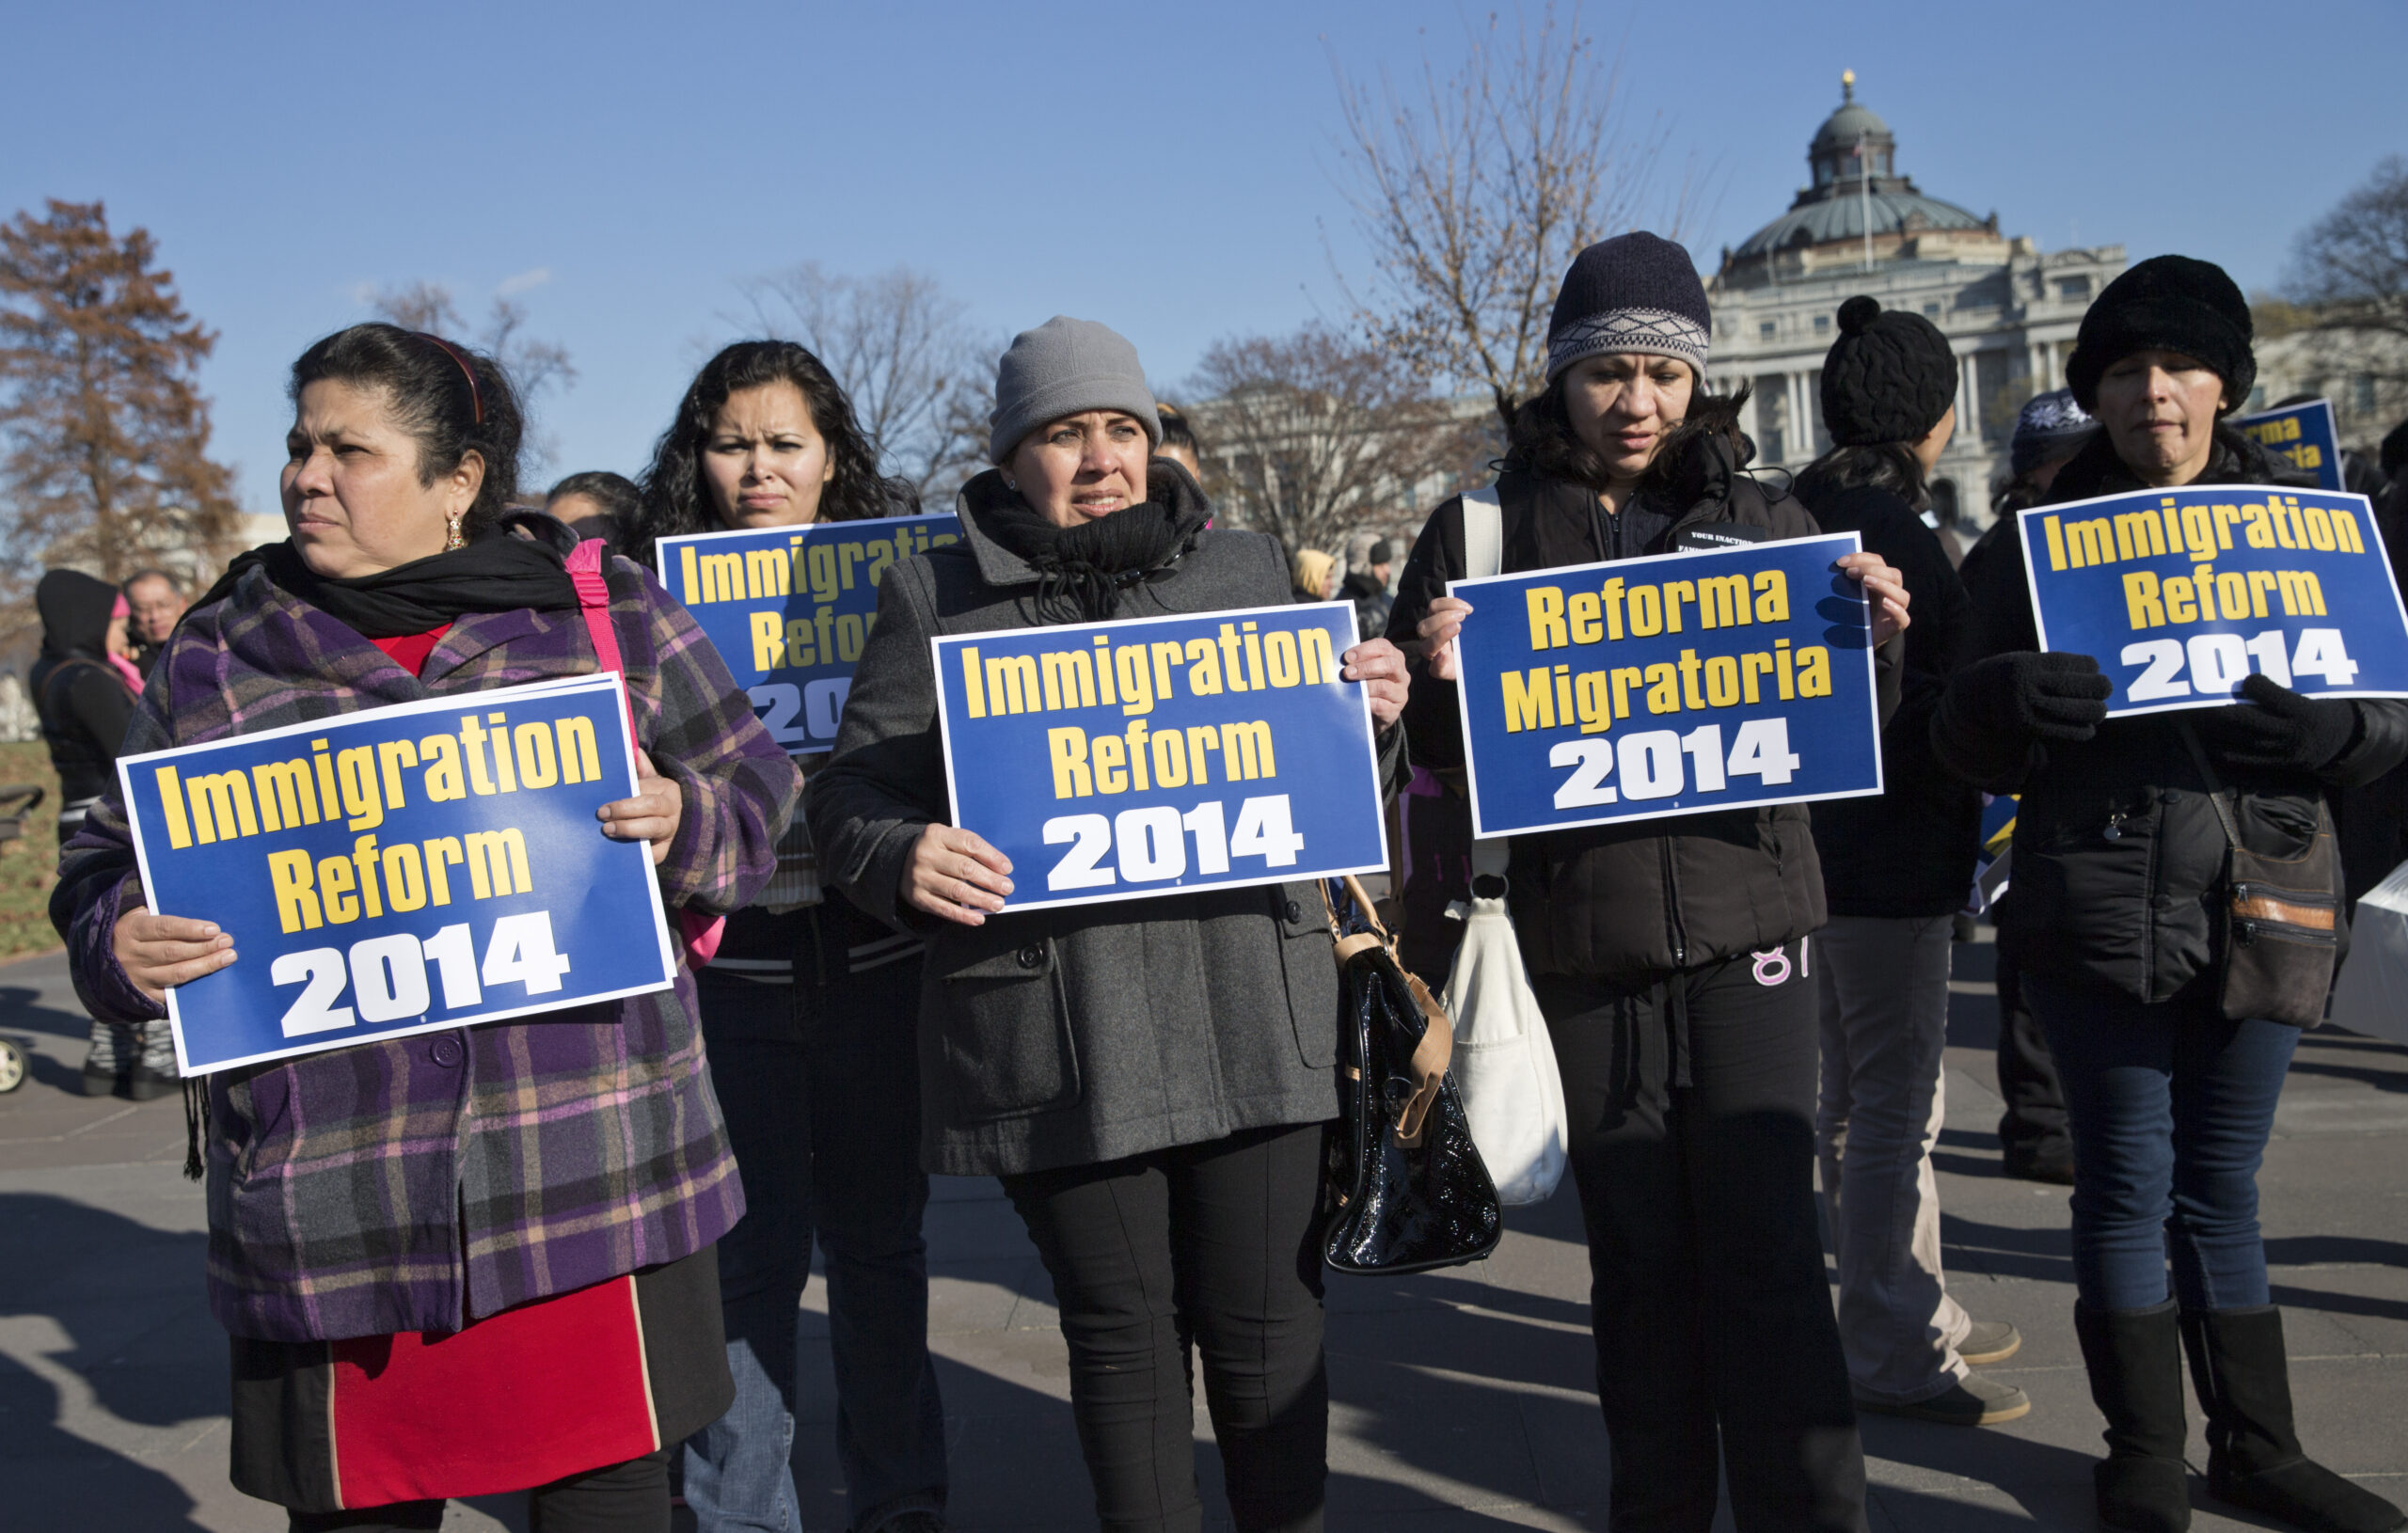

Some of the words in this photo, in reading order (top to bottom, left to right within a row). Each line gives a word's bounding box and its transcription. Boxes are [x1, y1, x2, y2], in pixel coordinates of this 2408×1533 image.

[1691, 531, 1714, 541] YOUR
[2043, 496, 2365, 571] Immigration
[750, 606, 878, 672] Refo
[1525, 570, 1791, 651] Reforma
[2121, 562, 2328, 631] Reform
[961, 622, 1334, 717] Immigration
[1500, 640, 1833, 735] Migratoria
[2121, 628, 2359, 703] 2014
[155, 712, 603, 833] Immigration
[1048, 719, 1277, 800] Reform
[1549, 717, 1801, 811] 2014
[267, 827, 533, 935] Reform
[1042, 793, 1306, 891] 2014
[270, 909, 571, 1039] 2014
